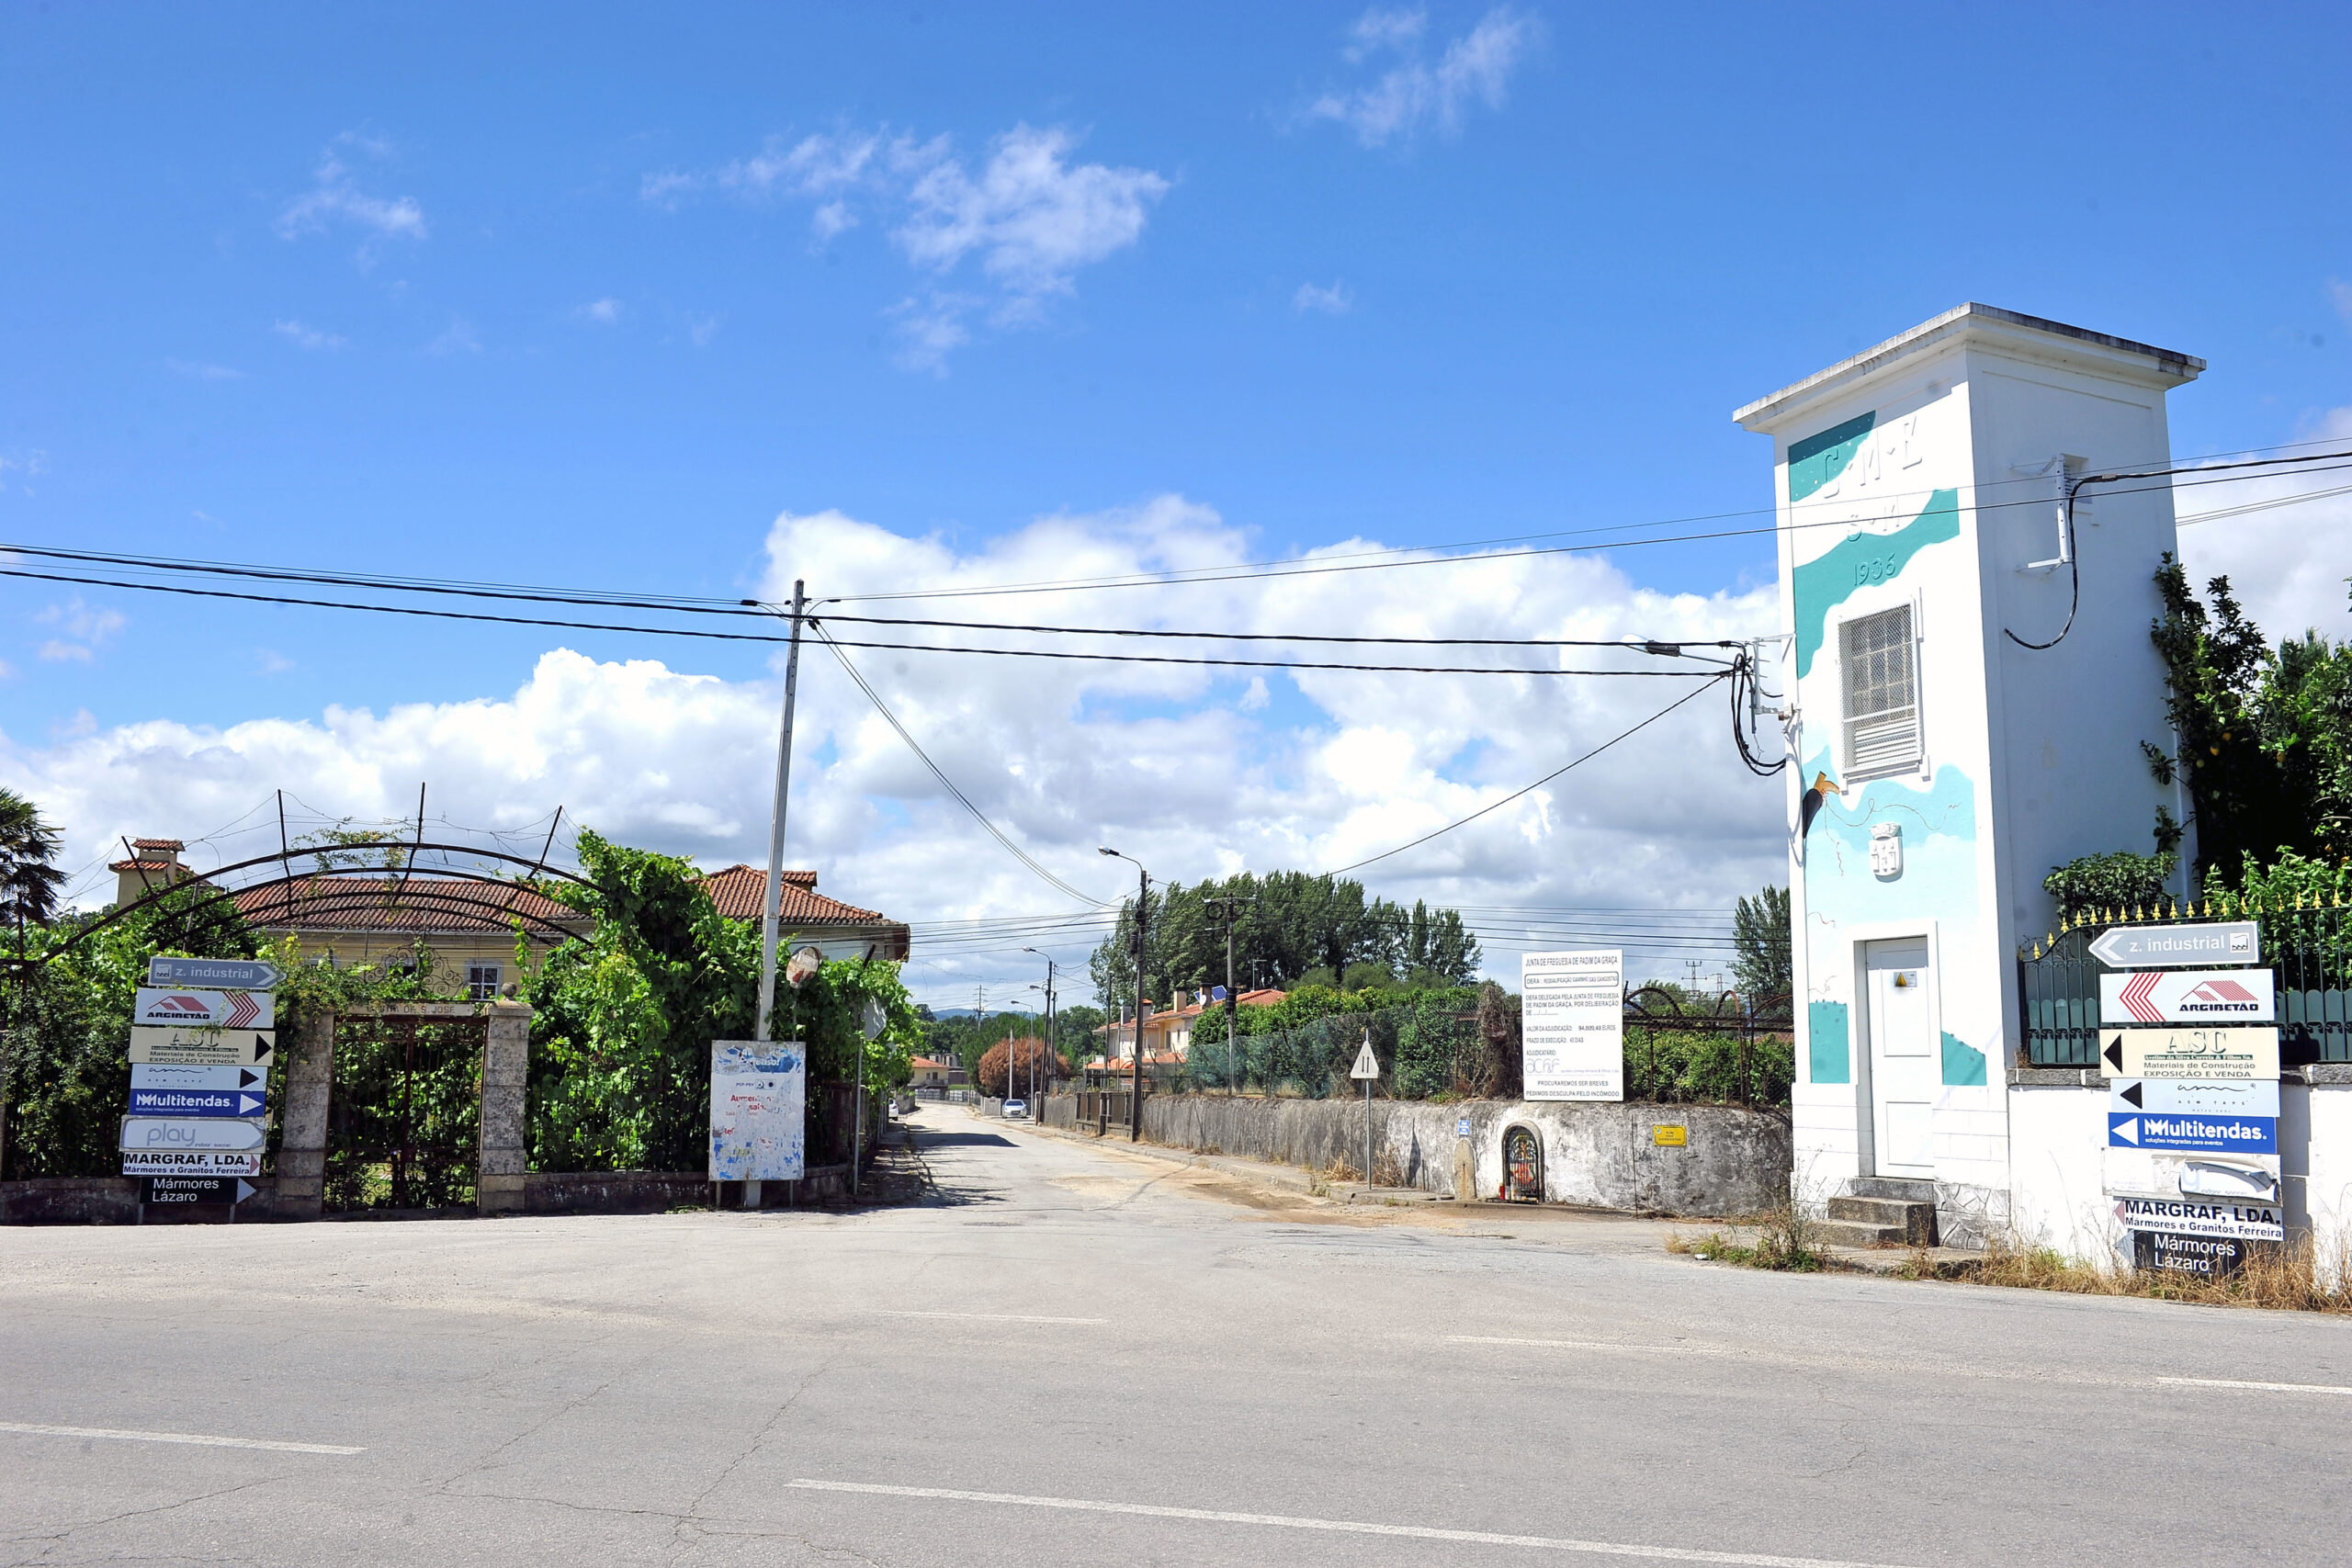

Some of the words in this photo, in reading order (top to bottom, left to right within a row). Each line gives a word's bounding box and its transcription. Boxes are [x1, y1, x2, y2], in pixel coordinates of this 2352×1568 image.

[2129, 942, 2143, 953] z.
[2147, 935, 2225, 952] industrial
[1526, 958, 1539, 966] JUNTA
[1540, 958, 1546, 966] DE
[1546, 957, 1571, 965] FREGUESIA
[1594, 956, 1600, 964] DA
[1601, 956, 1618, 965] GRAÇA
[175, 968, 186, 976] z.
[190, 966, 254, 979] industrial
[2165, 1031, 2227, 1054] ASC
[2144, 1069, 2202, 1078] EXPOSIÇÃO
[147, 1122, 196, 1146] play
[124, 1154, 209, 1167] MARGRAF,
[214, 1155, 250, 1166] LDA.
[123, 1166, 166, 1174] Mármores
[216, 1167, 250, 1175] Ferreira
[153, 1178, 219, 1190] Mármores
[153, 1191, 198, 1202] Lázaro
[2124, 1200, 2226, 1224] MARGRAF,
[2233, 1207, 2281, 1225] LDA.
[2125, 1215, 2176, 1230] Mármores
[2188, 1222, 2234, 1234] Granitos
[2238, 1225, 2282, 1238] Ferreira
[2154, 1234, 2236, 1257] Mármores
[2154, 1251, 2210, 1272] Lázaro
